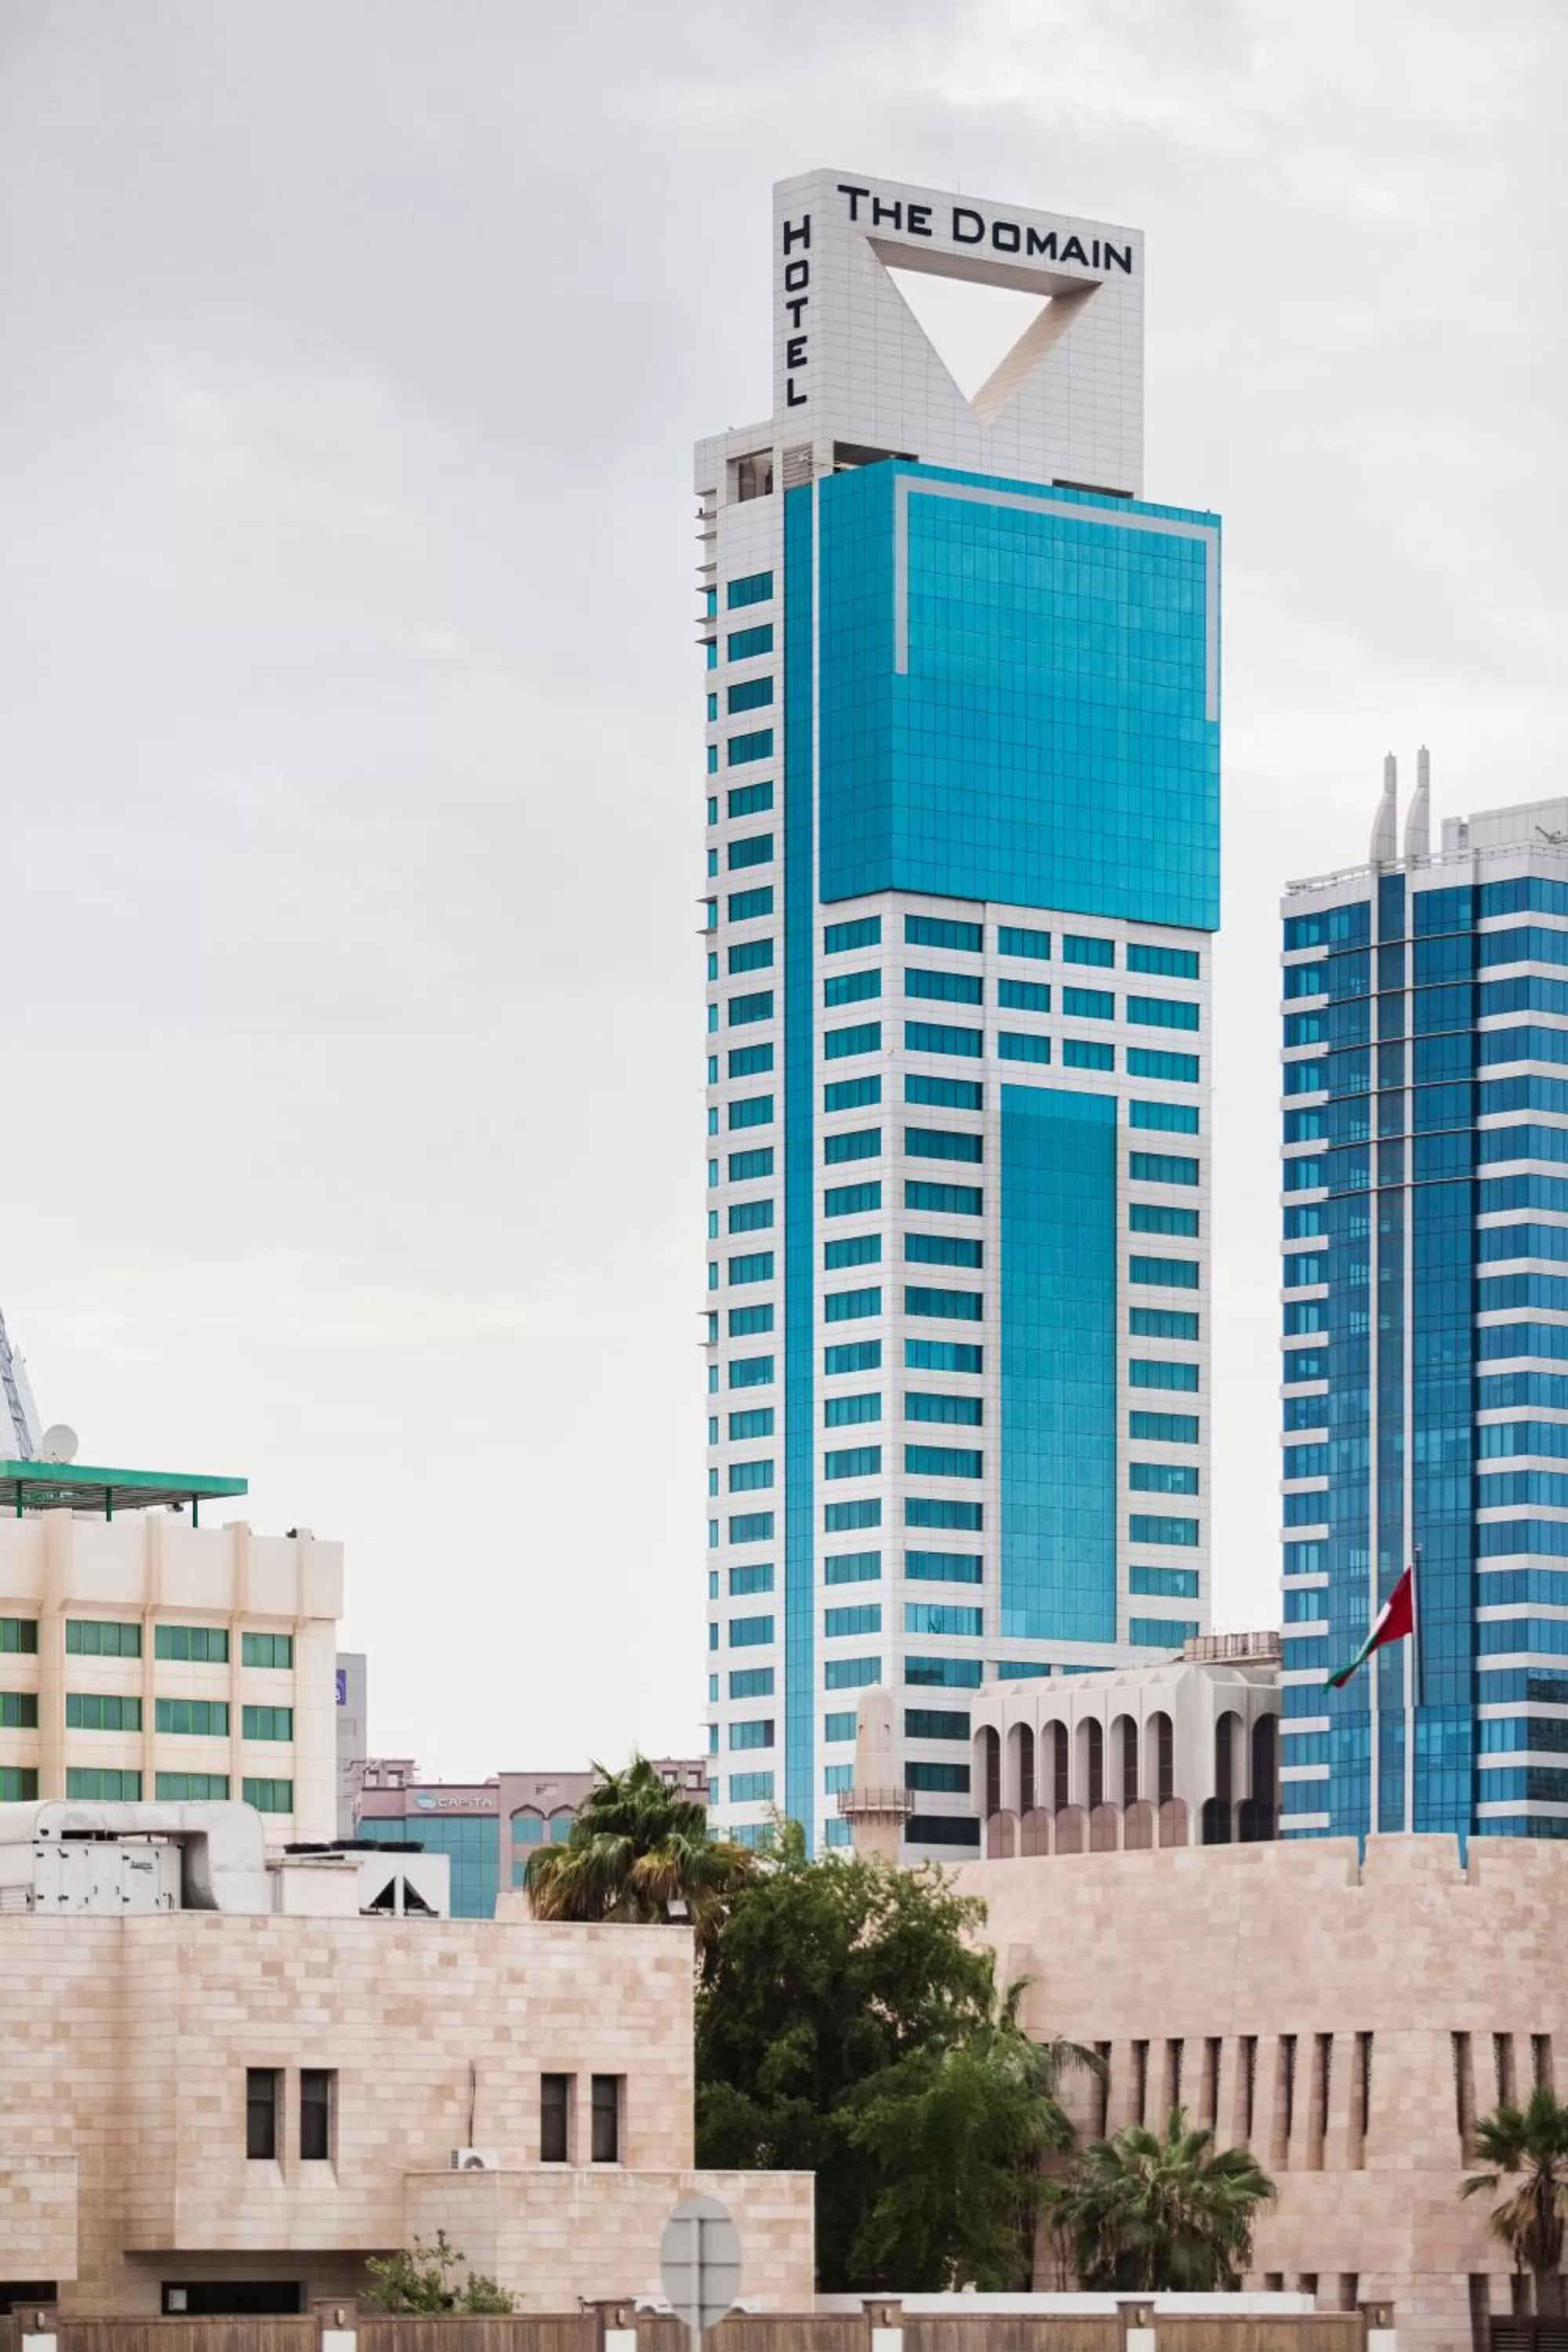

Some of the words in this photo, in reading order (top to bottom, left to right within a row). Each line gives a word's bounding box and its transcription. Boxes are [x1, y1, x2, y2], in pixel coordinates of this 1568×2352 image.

[837, 184, 932, 237] THE
[953, 207, 1132, 274] DOMAIN
[783, 214, 811, 407] HOTEL
